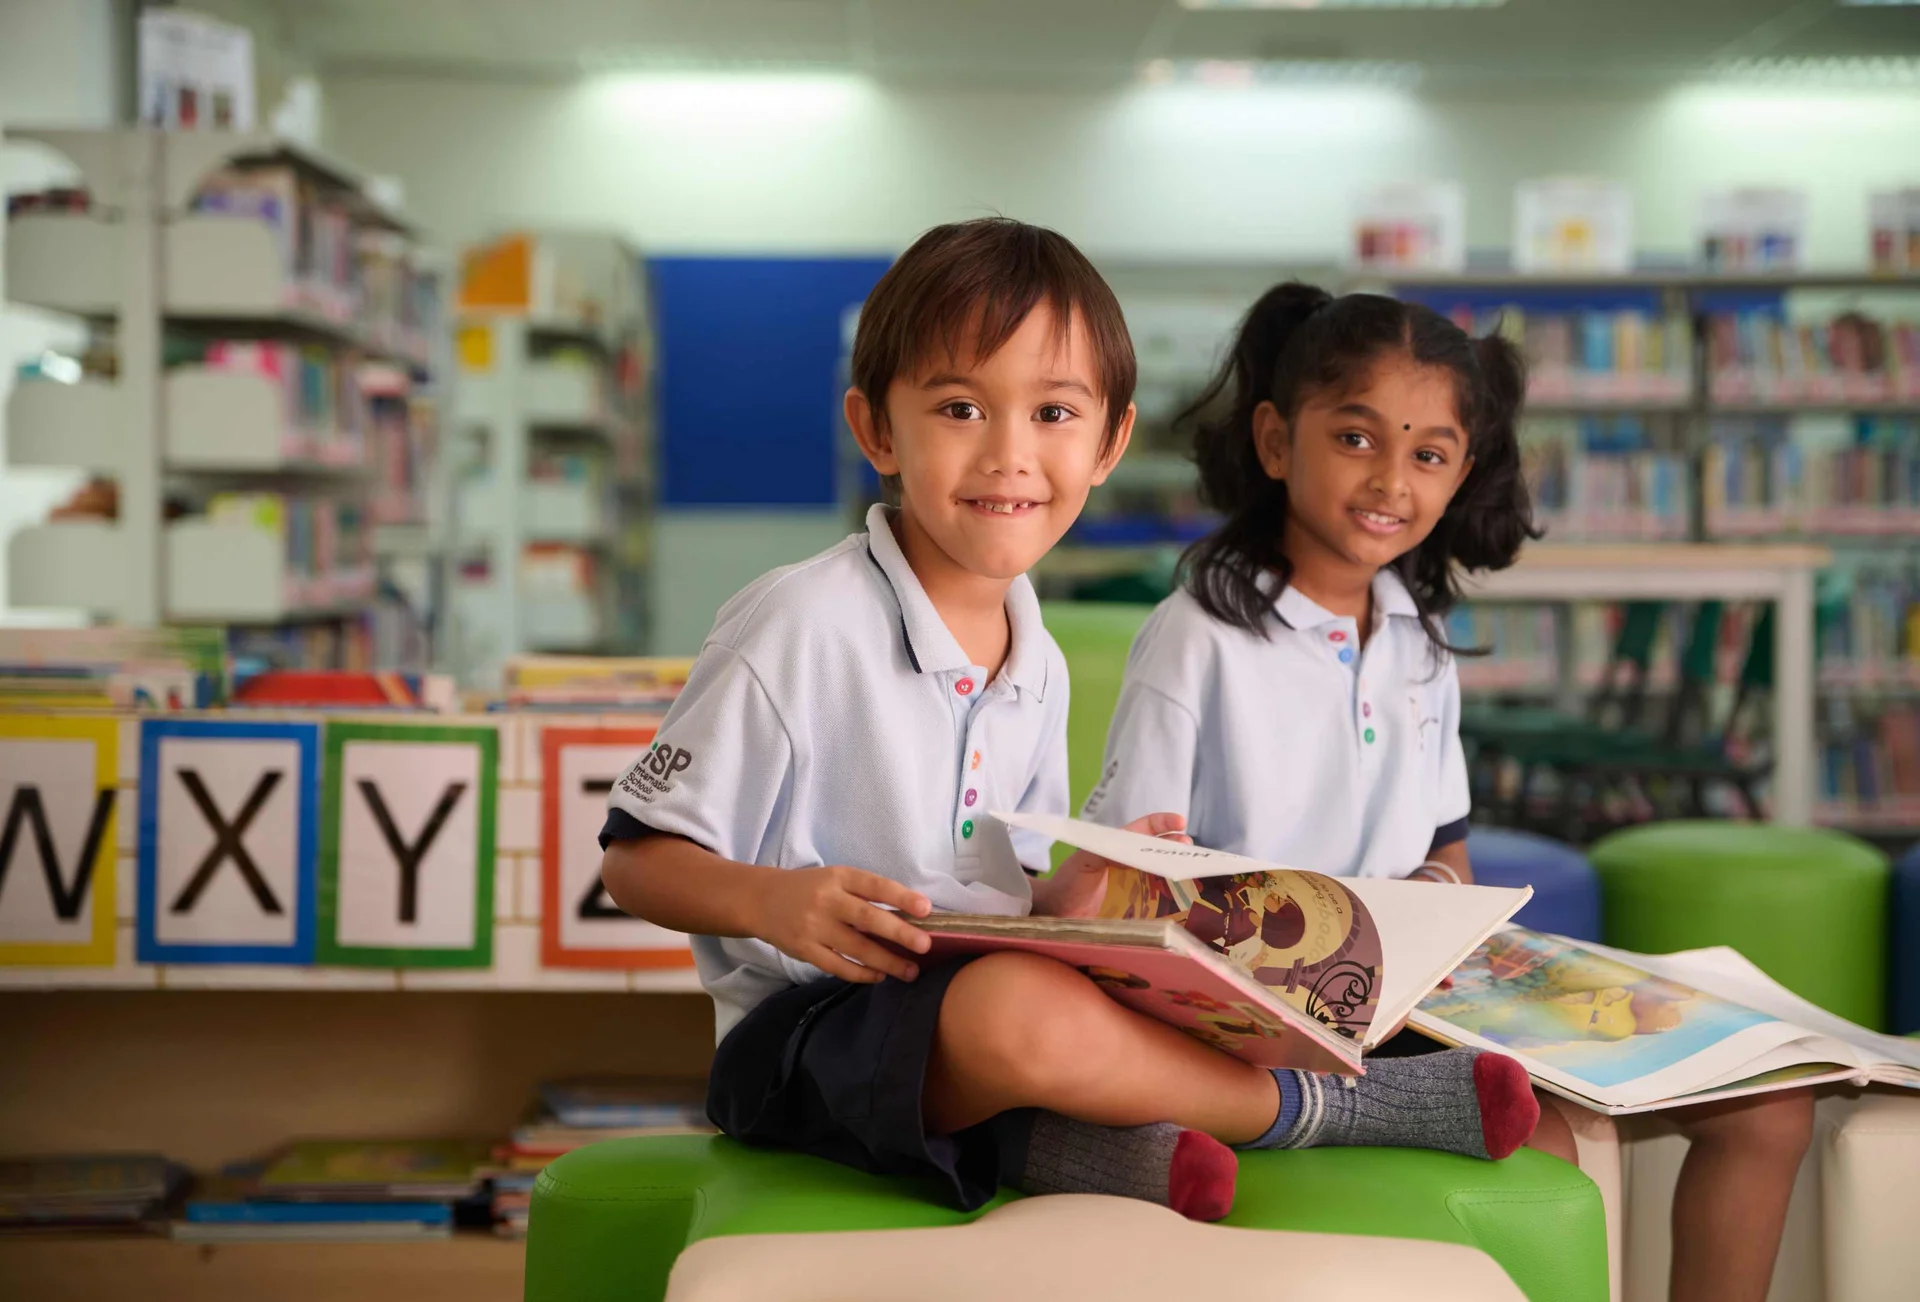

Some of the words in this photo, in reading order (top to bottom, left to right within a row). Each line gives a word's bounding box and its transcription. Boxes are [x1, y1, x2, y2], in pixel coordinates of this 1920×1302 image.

[626, 772, 654, 795] Schools
[0, 785, 116, 922] W
[170, 769, 285, 917] X
[357, 780, 468, 924] Y
